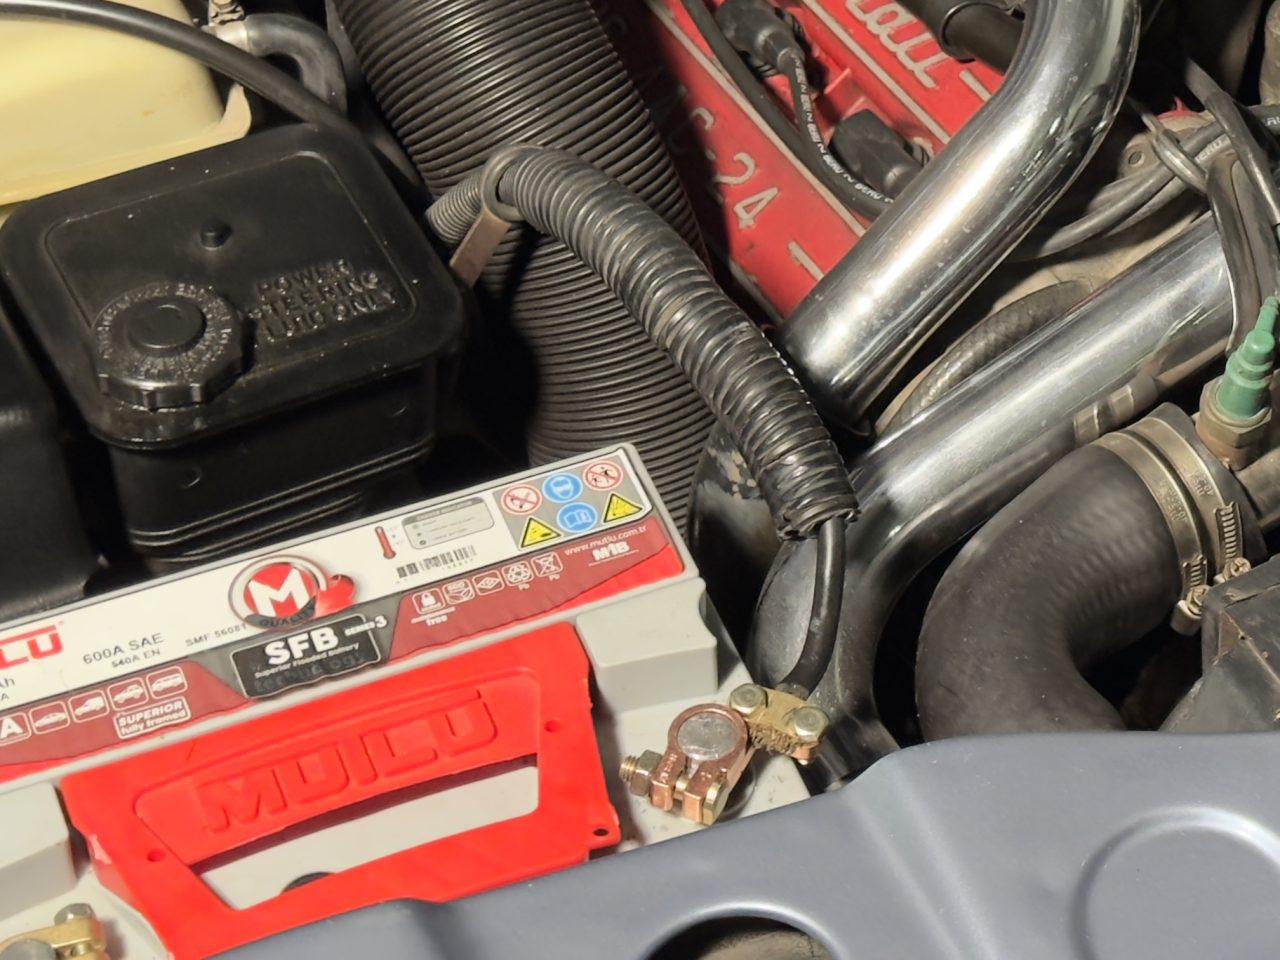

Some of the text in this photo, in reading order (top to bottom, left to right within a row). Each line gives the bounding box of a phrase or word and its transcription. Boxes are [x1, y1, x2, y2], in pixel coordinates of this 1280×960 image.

[83, 633, 165, 665] 600A SAE
[143, 649, 162, 662] EN
[265, 626, 339, 666] SFB
[118, 701, 183, 727] SUPERIOR
